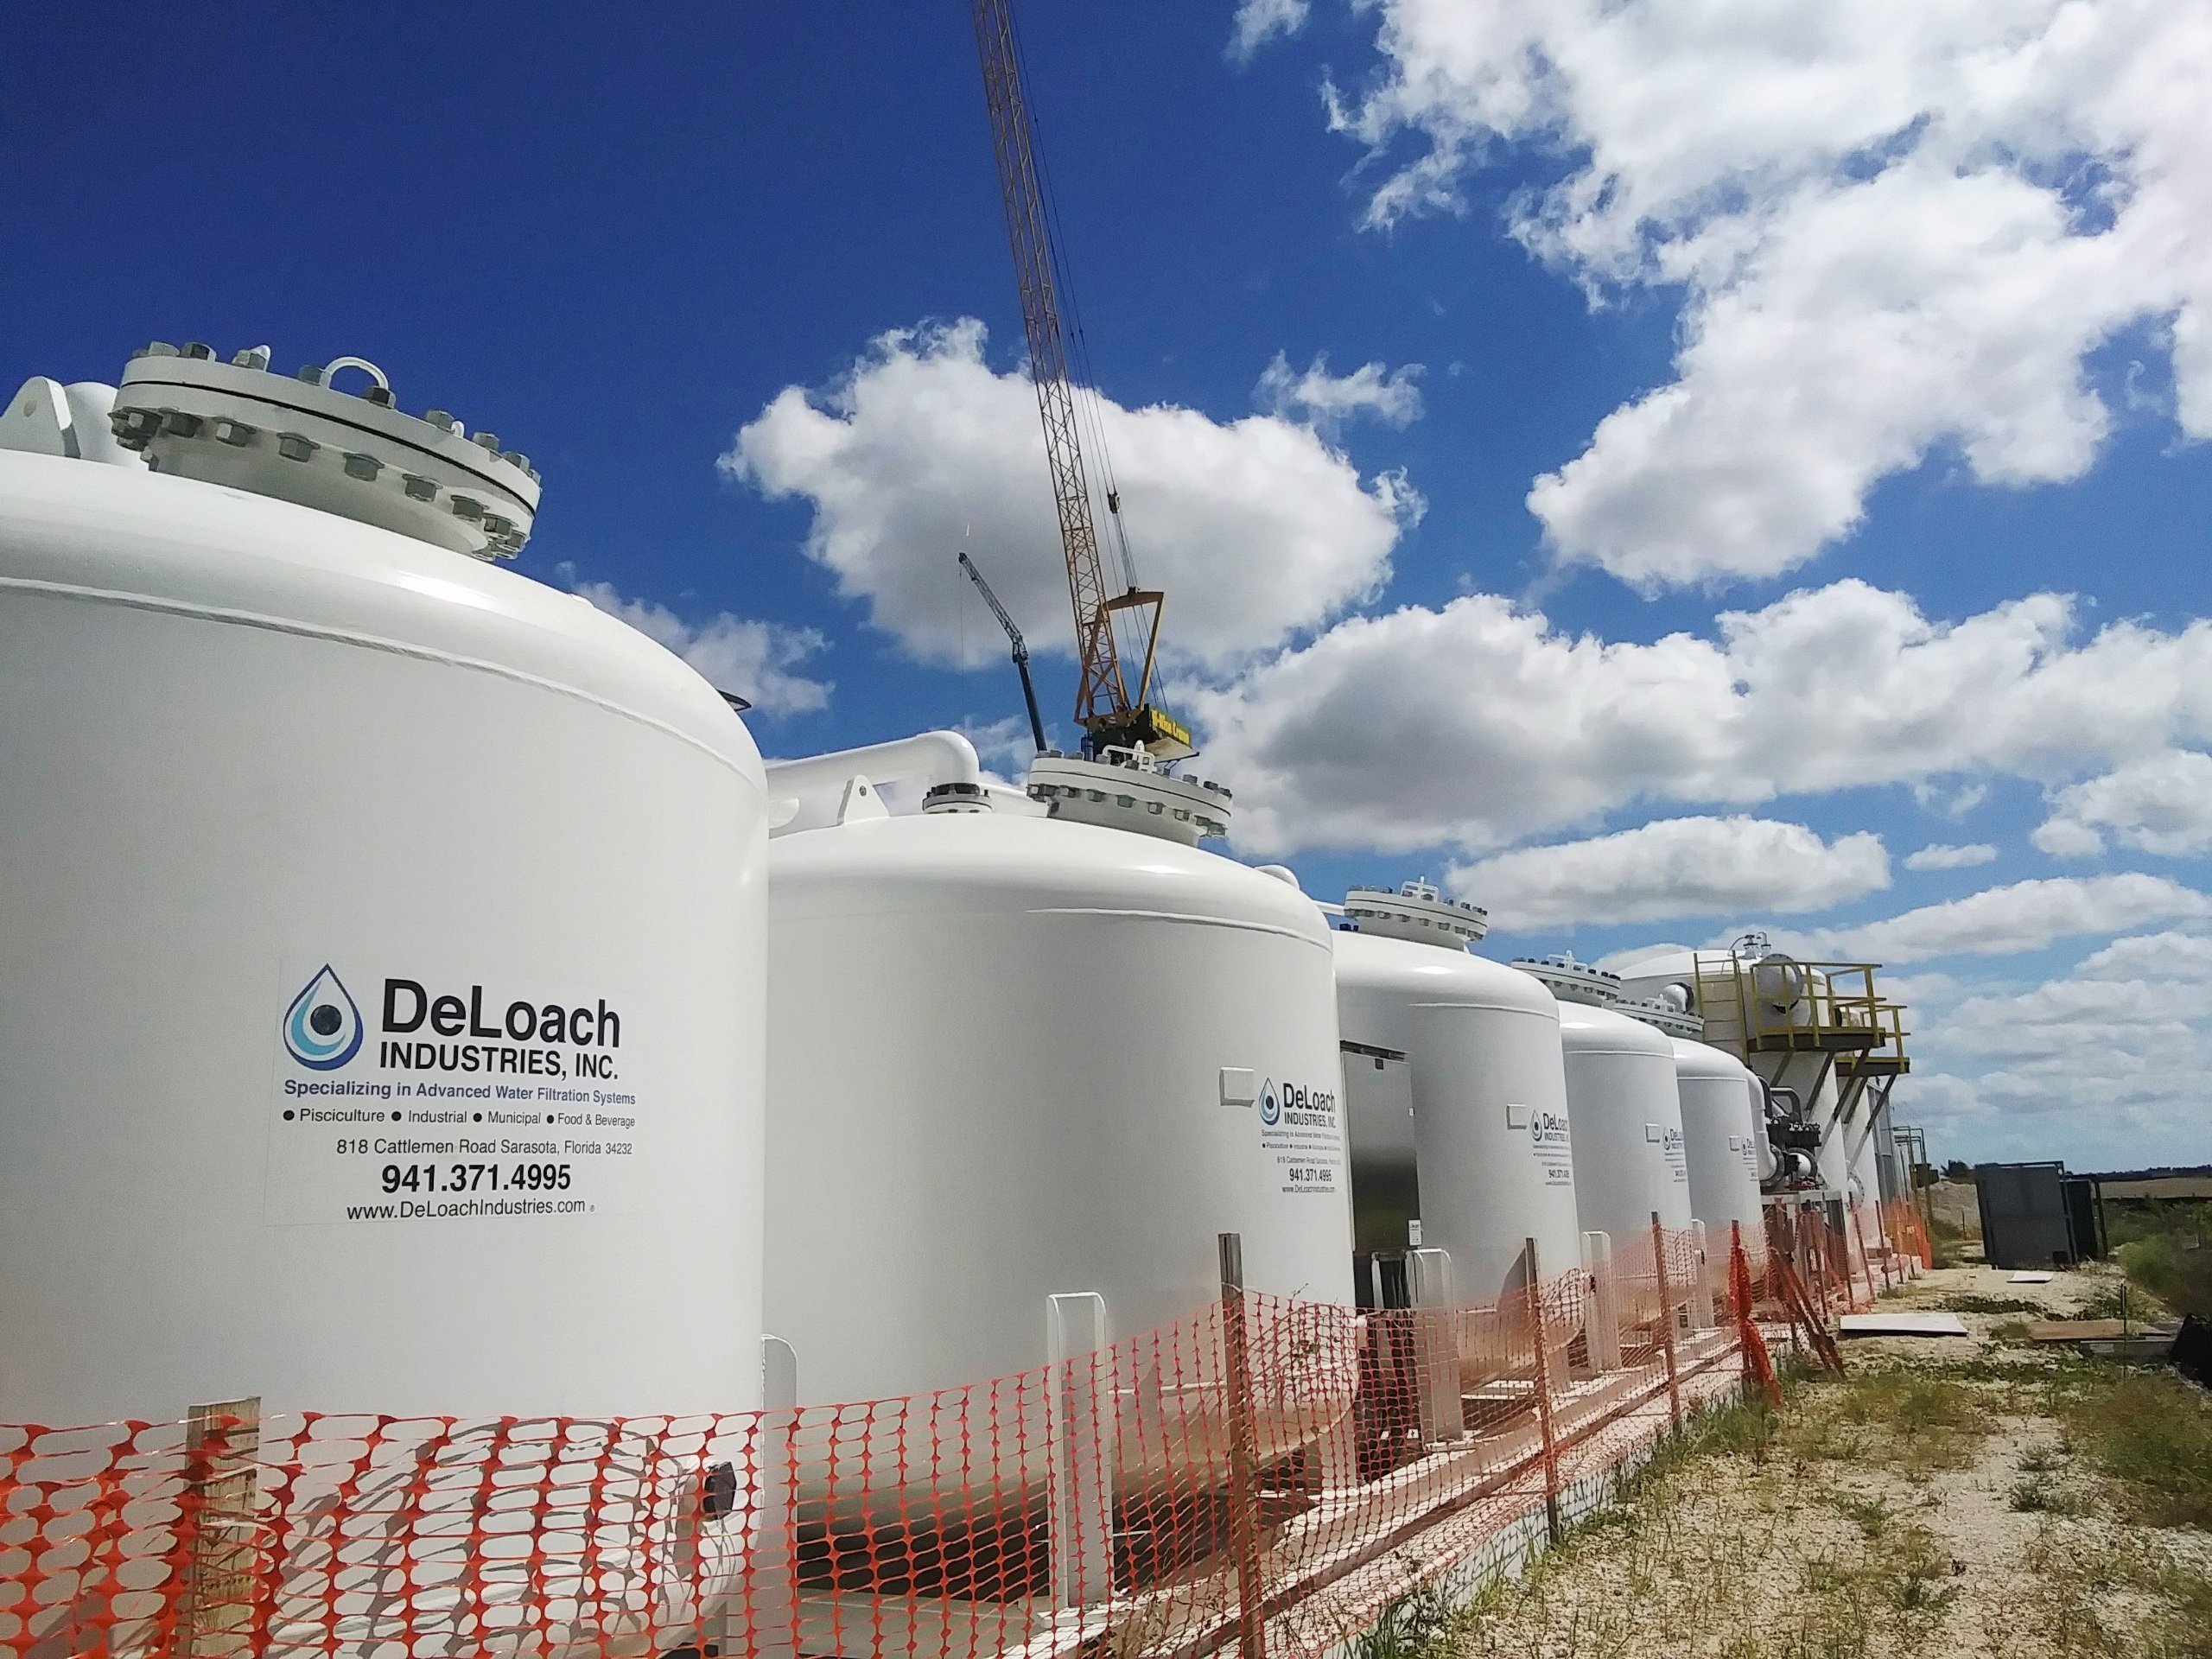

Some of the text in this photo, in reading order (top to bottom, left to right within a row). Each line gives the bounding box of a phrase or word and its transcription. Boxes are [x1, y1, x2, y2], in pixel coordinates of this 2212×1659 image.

[381, 977, 620, 1049] DeLoach
[379, 1040, 619, 1081] INDUSTRIES, INC.
[283, 1078, 636, 1107] Specializing in Advanced Water Filtration Systems
[1283, 1082, 1336, 1114] DeLoach
[299, 1108, 636, 1130] Pisciculture Industrial Municipal Food & Beverage
[336, 1138, 633, 1155] 818 Cattlemen Road Sarasota, Florida 34232
[381, 1163, 572, 1194] 941.371.4995
[1289, 1167, 1332, 1183] 941.371.4995
[346, 1198, 586, 1221] www.DeLoachIndustries.com
